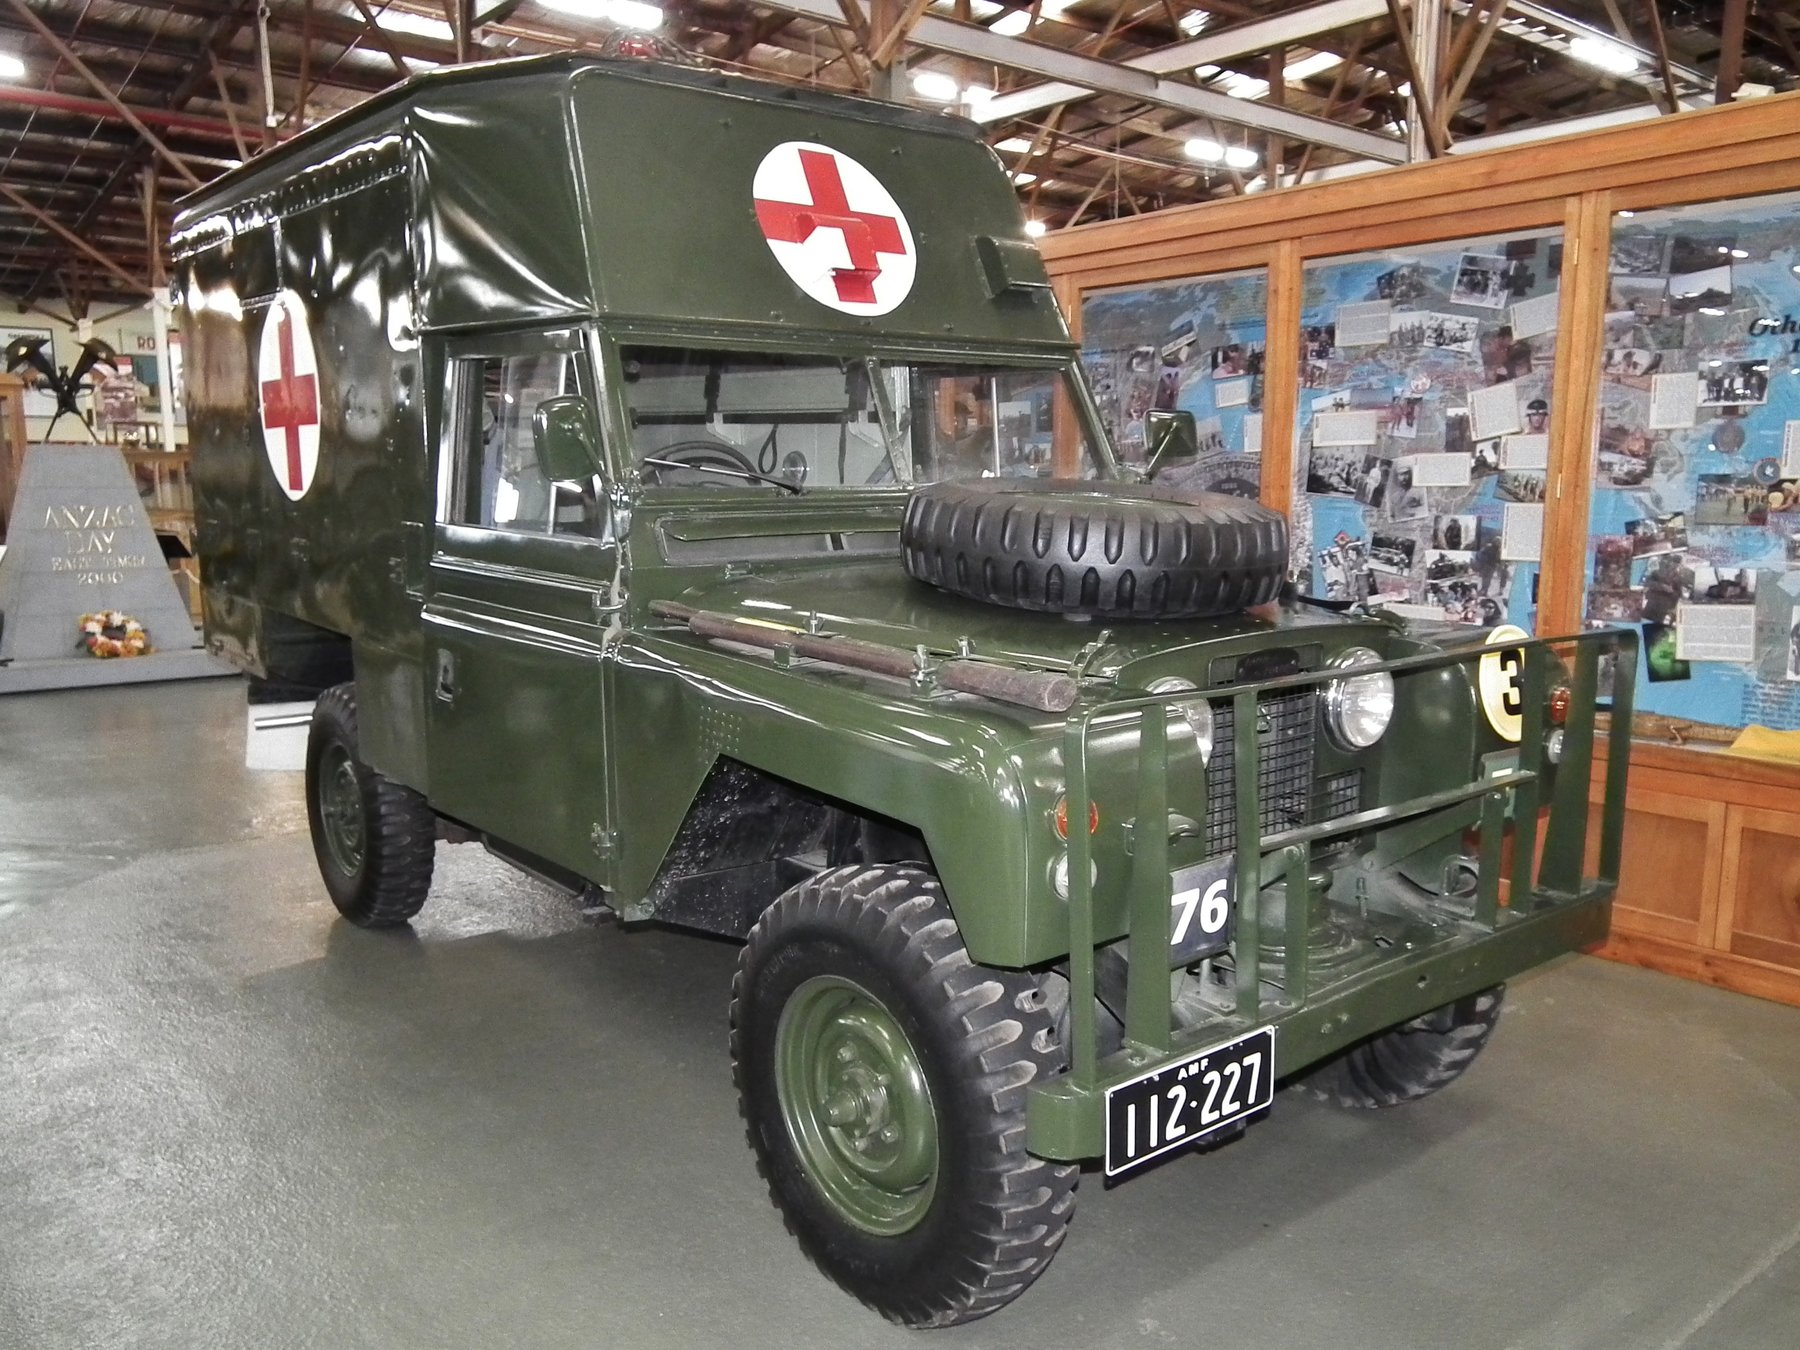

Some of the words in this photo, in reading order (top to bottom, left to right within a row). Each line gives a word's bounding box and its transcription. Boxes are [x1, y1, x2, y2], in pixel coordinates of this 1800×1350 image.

[1748, 314, 1800, 337] Oth
[43, 505, 135, 529] ANZAC
[64, 531, 115, 554] DAY
[1500, 648, 1523, 716] 3
[1170, 878, 1229, 946] 76
